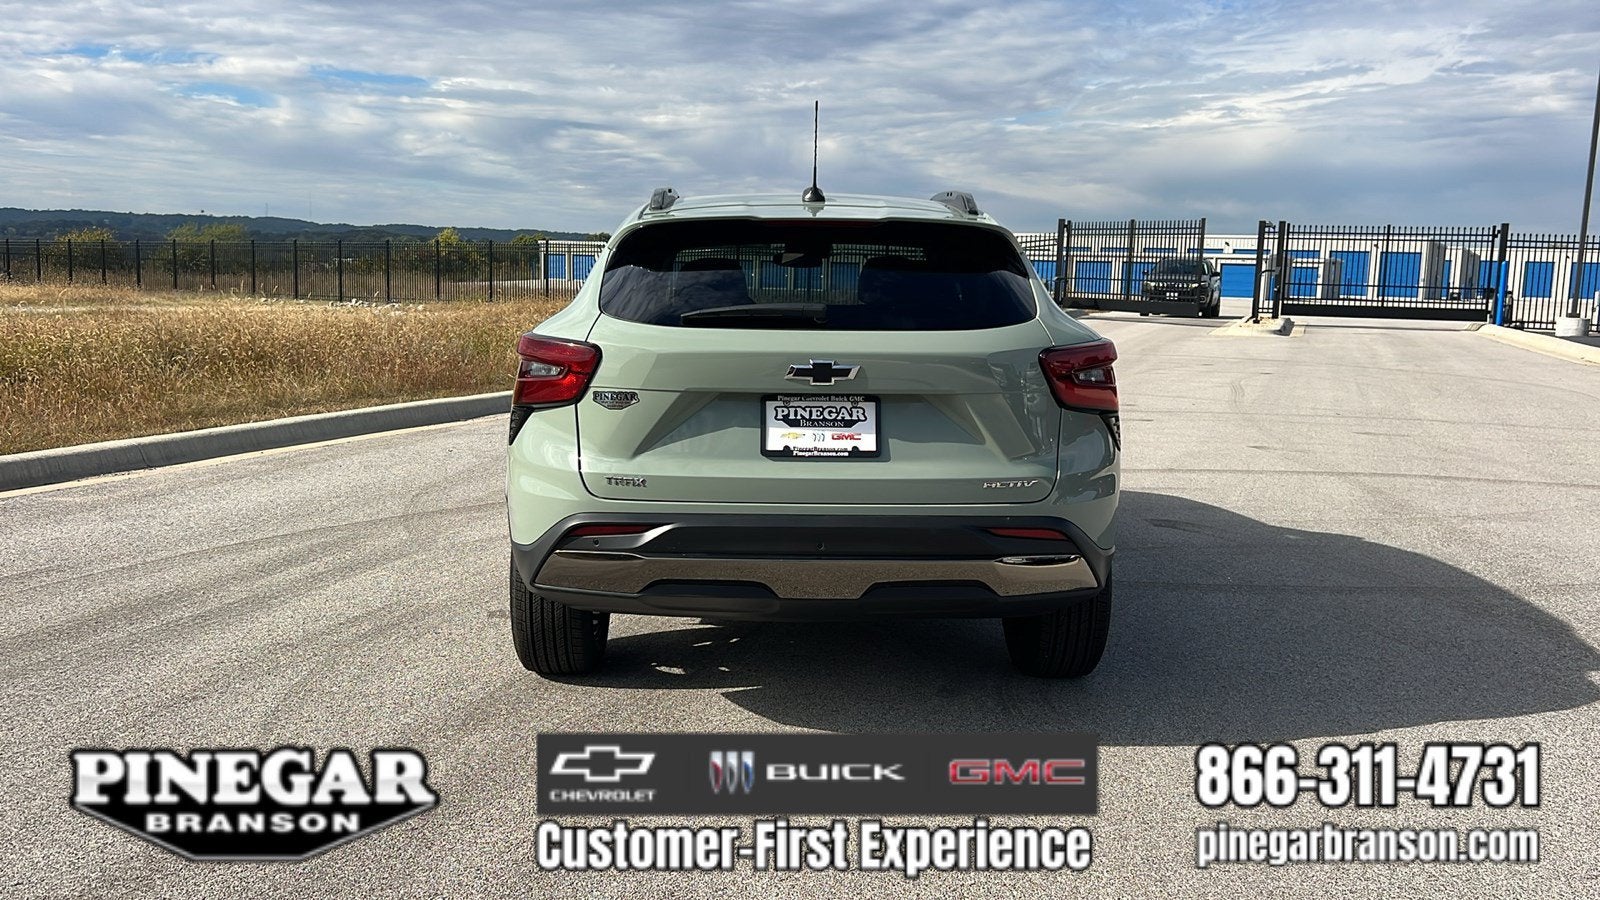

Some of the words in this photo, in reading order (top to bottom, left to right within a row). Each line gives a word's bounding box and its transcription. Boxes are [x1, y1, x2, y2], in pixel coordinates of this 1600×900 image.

[594, 392, 638, 401] PINEGAR
[775, 407, 867, 420] PINEGAR
[982, 479, 1038, 489] ACTIV
